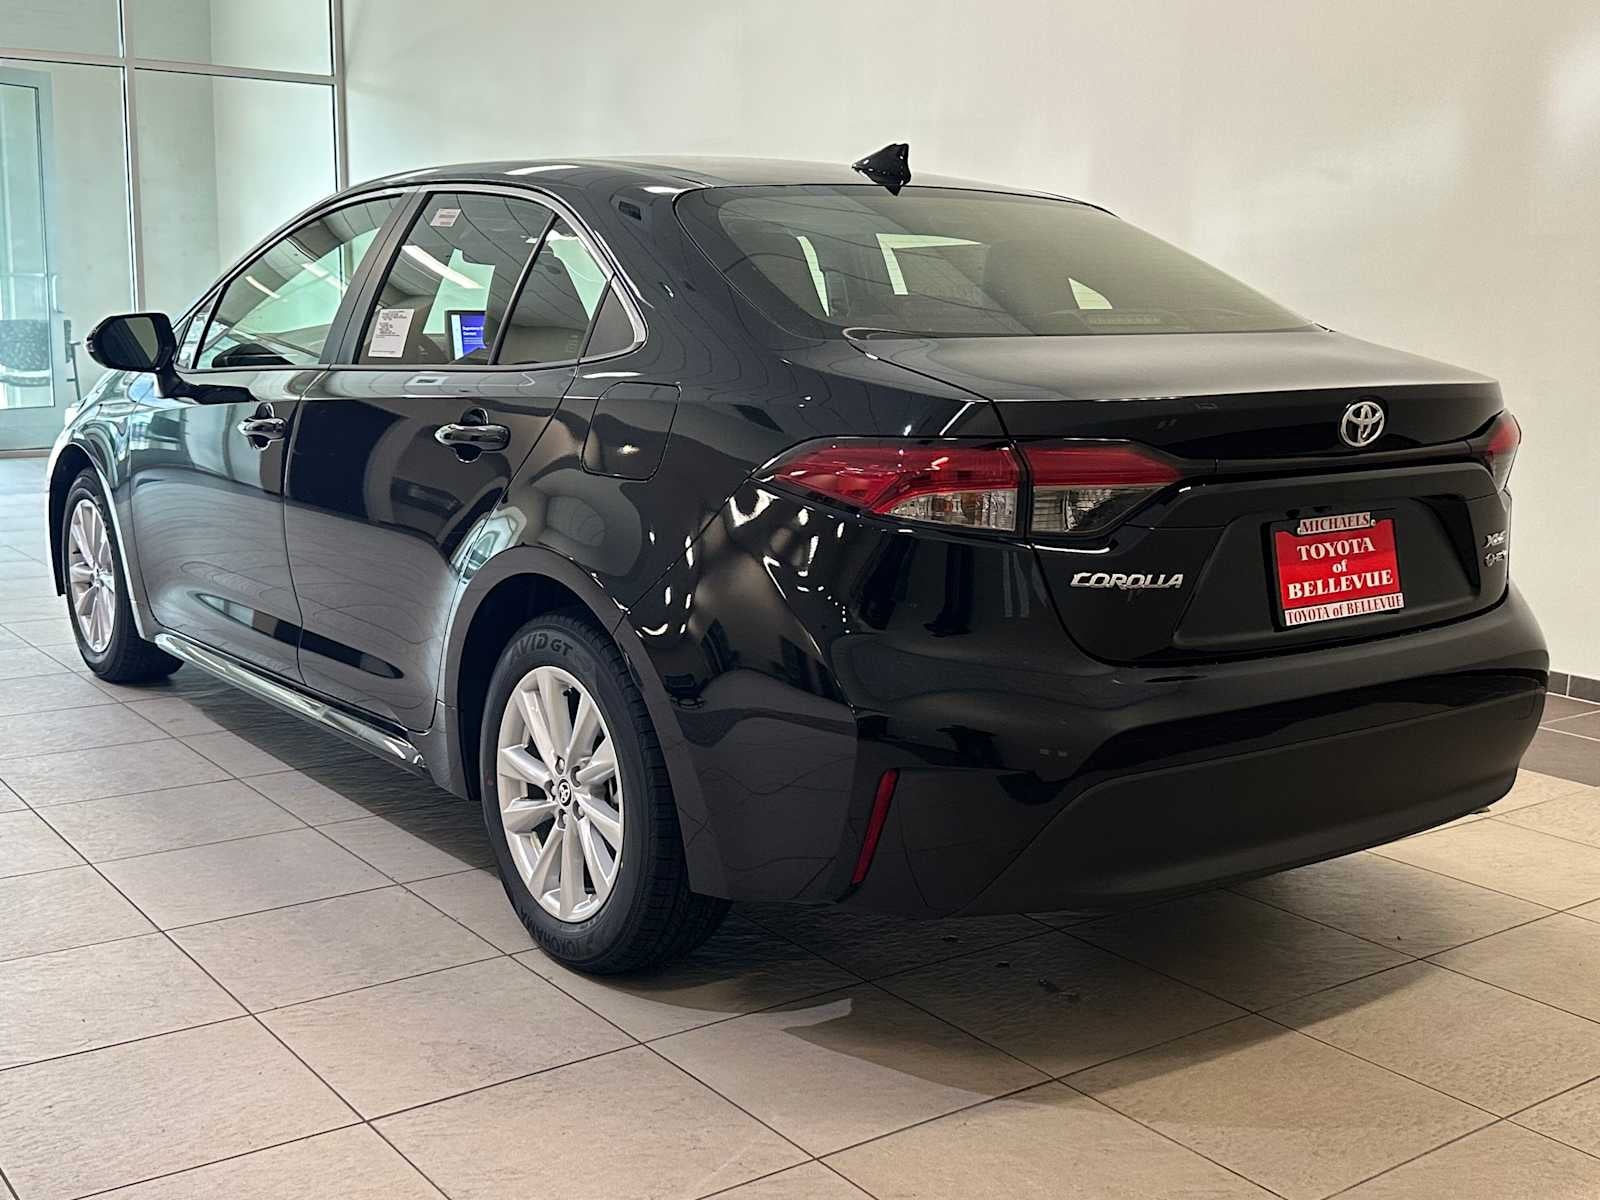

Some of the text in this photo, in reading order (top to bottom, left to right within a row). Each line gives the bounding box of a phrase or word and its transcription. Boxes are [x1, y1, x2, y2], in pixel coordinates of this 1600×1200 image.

[1302, 513, 1369, 532] MICHAELS
[1296, 537, 1375, 561] TOYOTA
[1332, 559, 1348, 574] of
[1070, 572, 1184, 590] COROLLA
[1287, 569, 1393, 600] BELLEVUE
[1287, 595, 1402, 624] TOYOTA of BELLEVUE
[550, 638, 574, 657] GT
